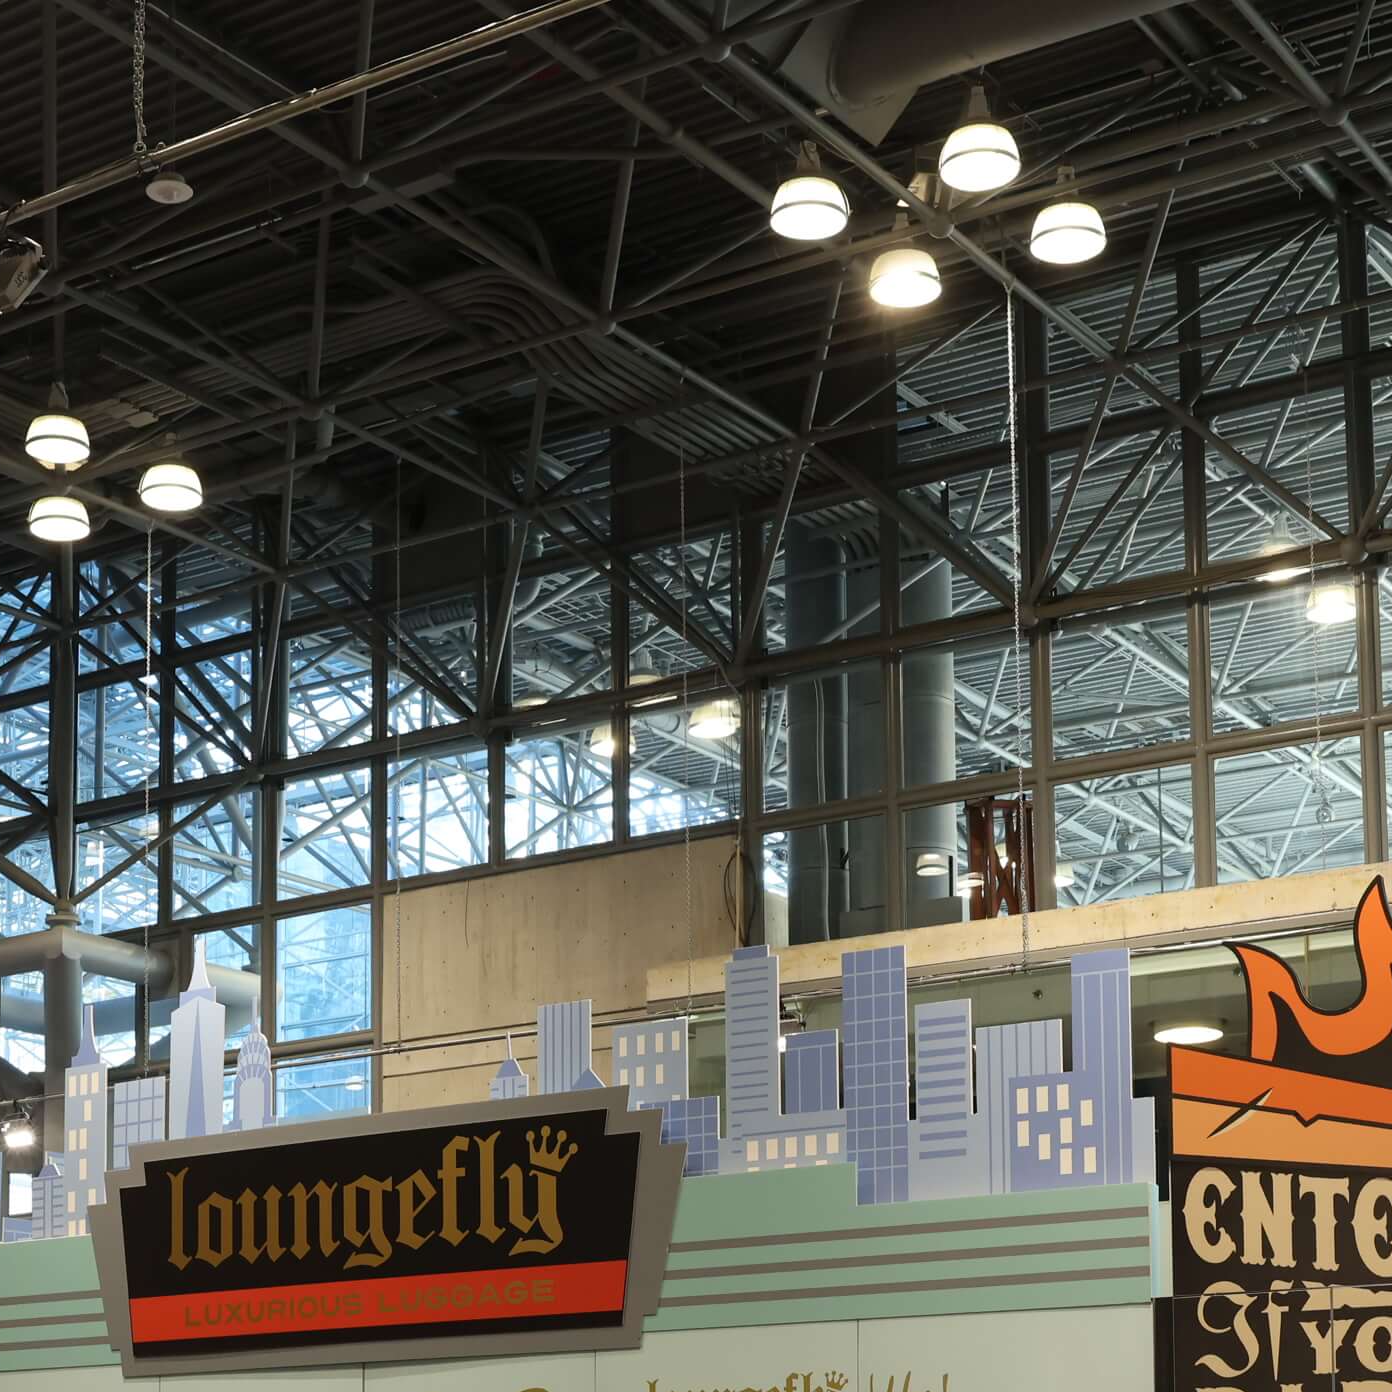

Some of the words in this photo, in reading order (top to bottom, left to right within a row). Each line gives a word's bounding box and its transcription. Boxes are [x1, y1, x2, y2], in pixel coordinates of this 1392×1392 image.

[166, 1131, 563, 1271] loungefly
[184, 1292, 363, 1329] LUXURIOUS
[377, 1279, 556, 1314] LUGGAGE
